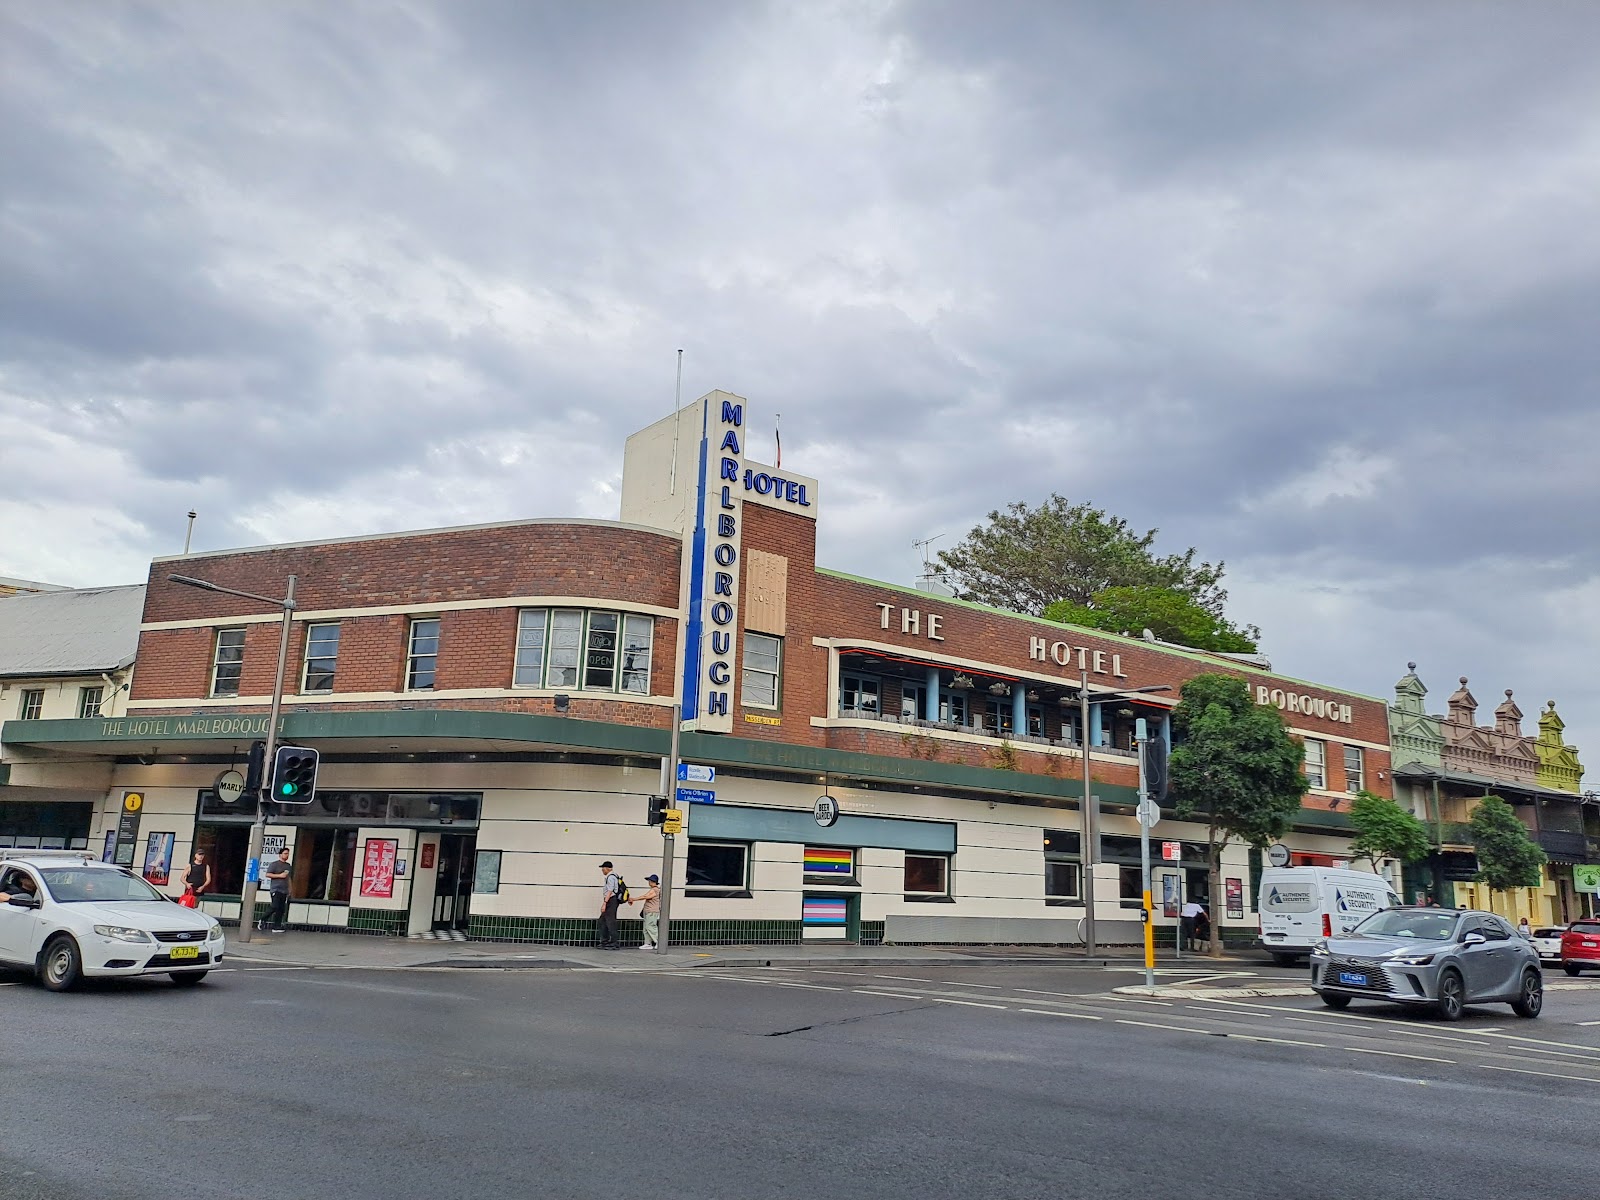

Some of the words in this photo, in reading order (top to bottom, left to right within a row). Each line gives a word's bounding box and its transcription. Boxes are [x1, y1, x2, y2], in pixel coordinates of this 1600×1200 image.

[708, 400, 742, 716] MARLBOROUGH
[876, 602, 945, 641] THE
[589, 655, 612, 666] OPEN
[1029, 636, 1128, 678] HOTEL
[1250, 684, 1352, 724] BOROUGH
[102, 720, 125, 736] THE
[128, 720, 171, 735] HOTEL
[219, 781, 243, 793] MARLY
[818, 803, 830, 812] BEER
[816, 811, 832, 821] GARDEN
[1346, 890, 1375, 900] AUTHENTIC
[1348, 899, 1373, 910] SECURITY
